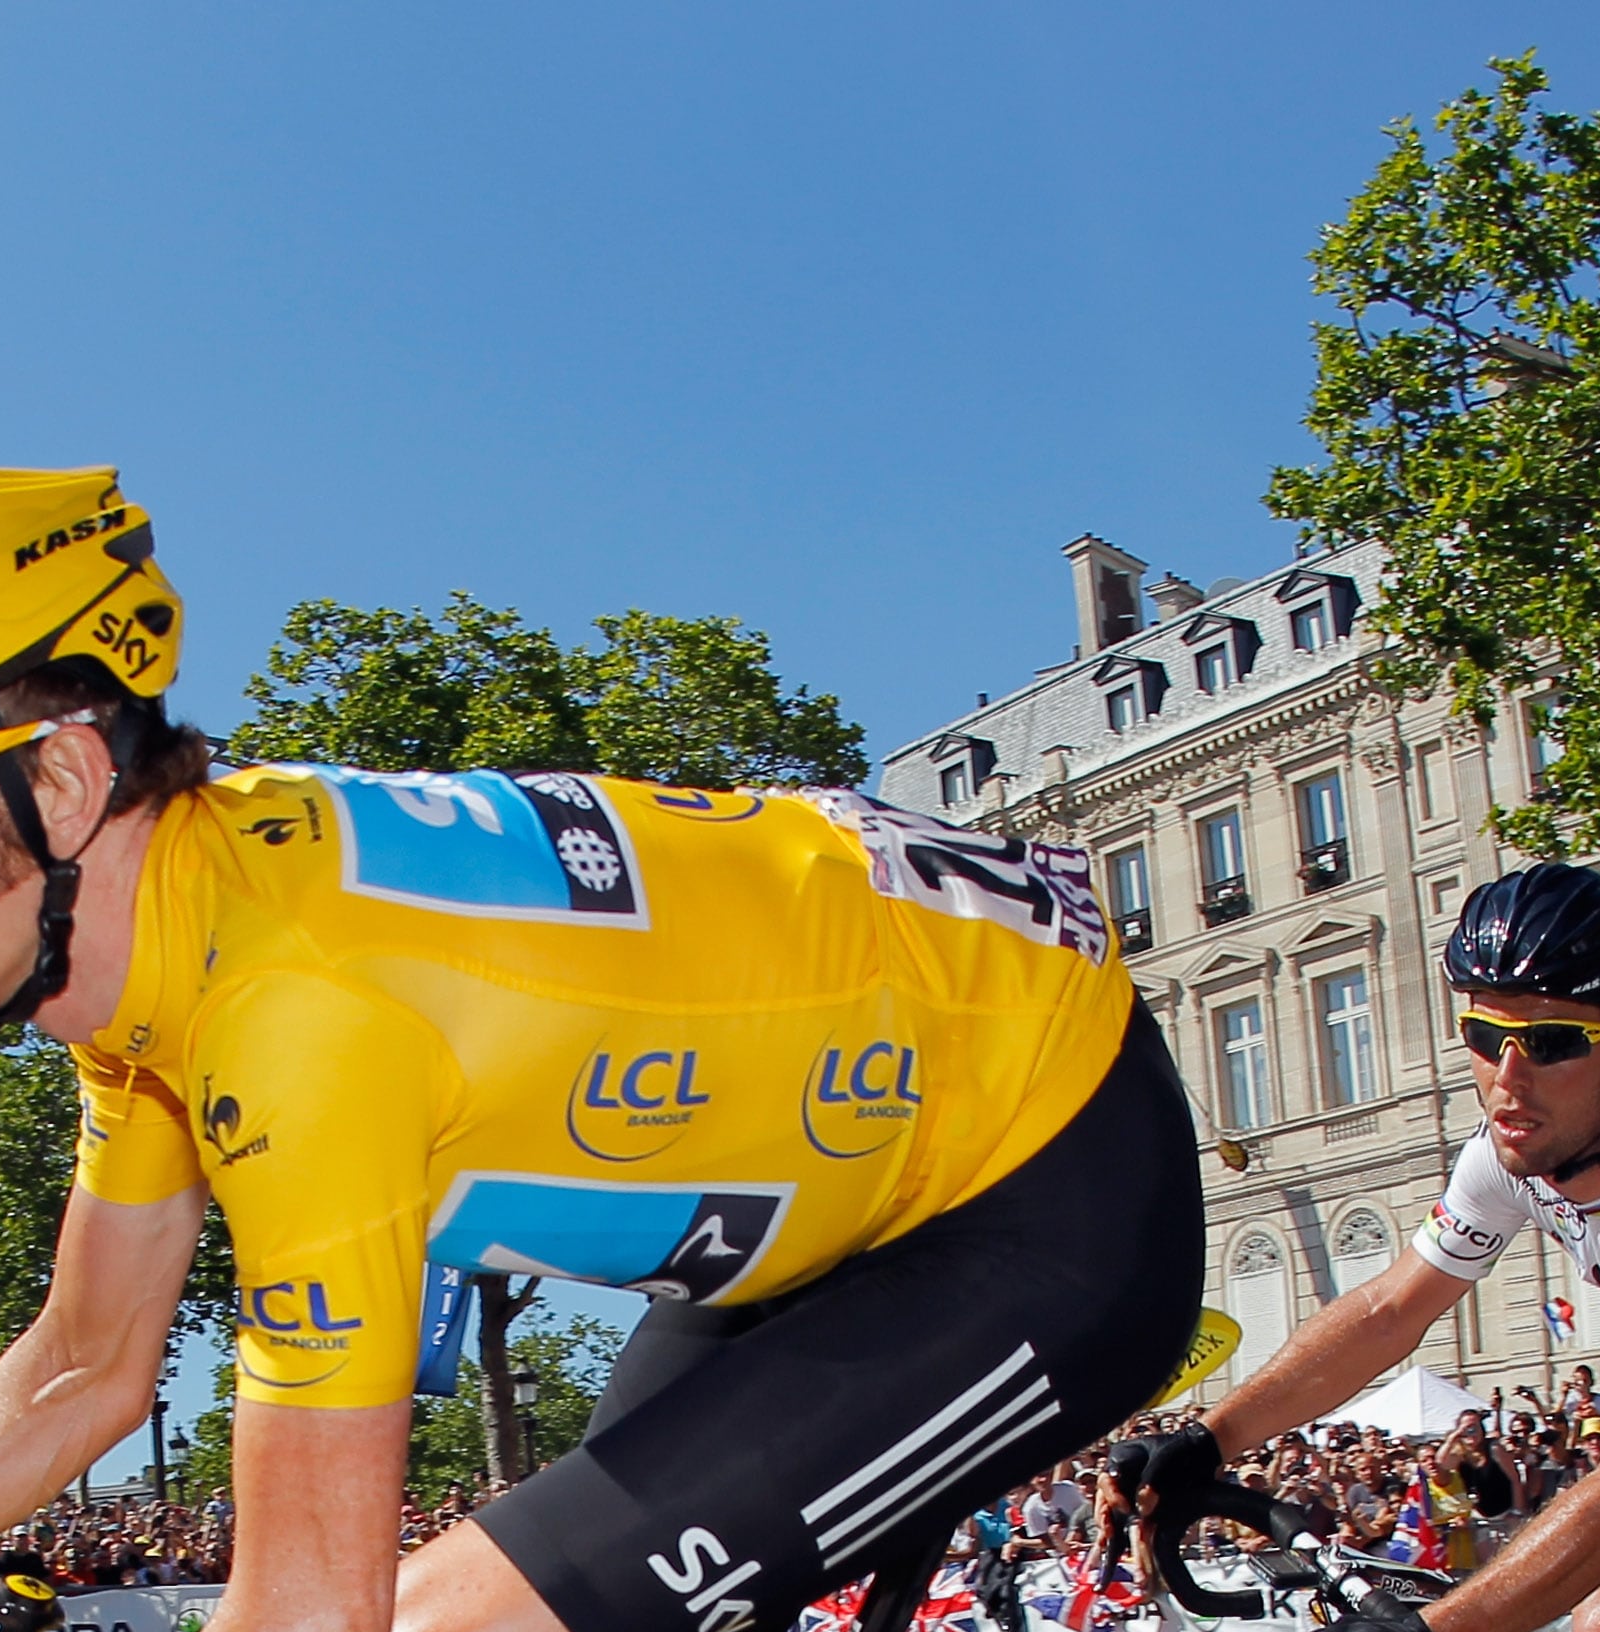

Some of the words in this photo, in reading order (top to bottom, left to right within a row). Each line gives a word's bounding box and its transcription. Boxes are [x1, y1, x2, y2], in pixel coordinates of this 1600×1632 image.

[15, 509, 126, 571] KASK
[92, 612, 159, 678] sky
[584, 1049, 711, 1110] LCL
[817, 1040, 923, 1104] LCL
[626, 1110, 693, 1128] BANQUE
